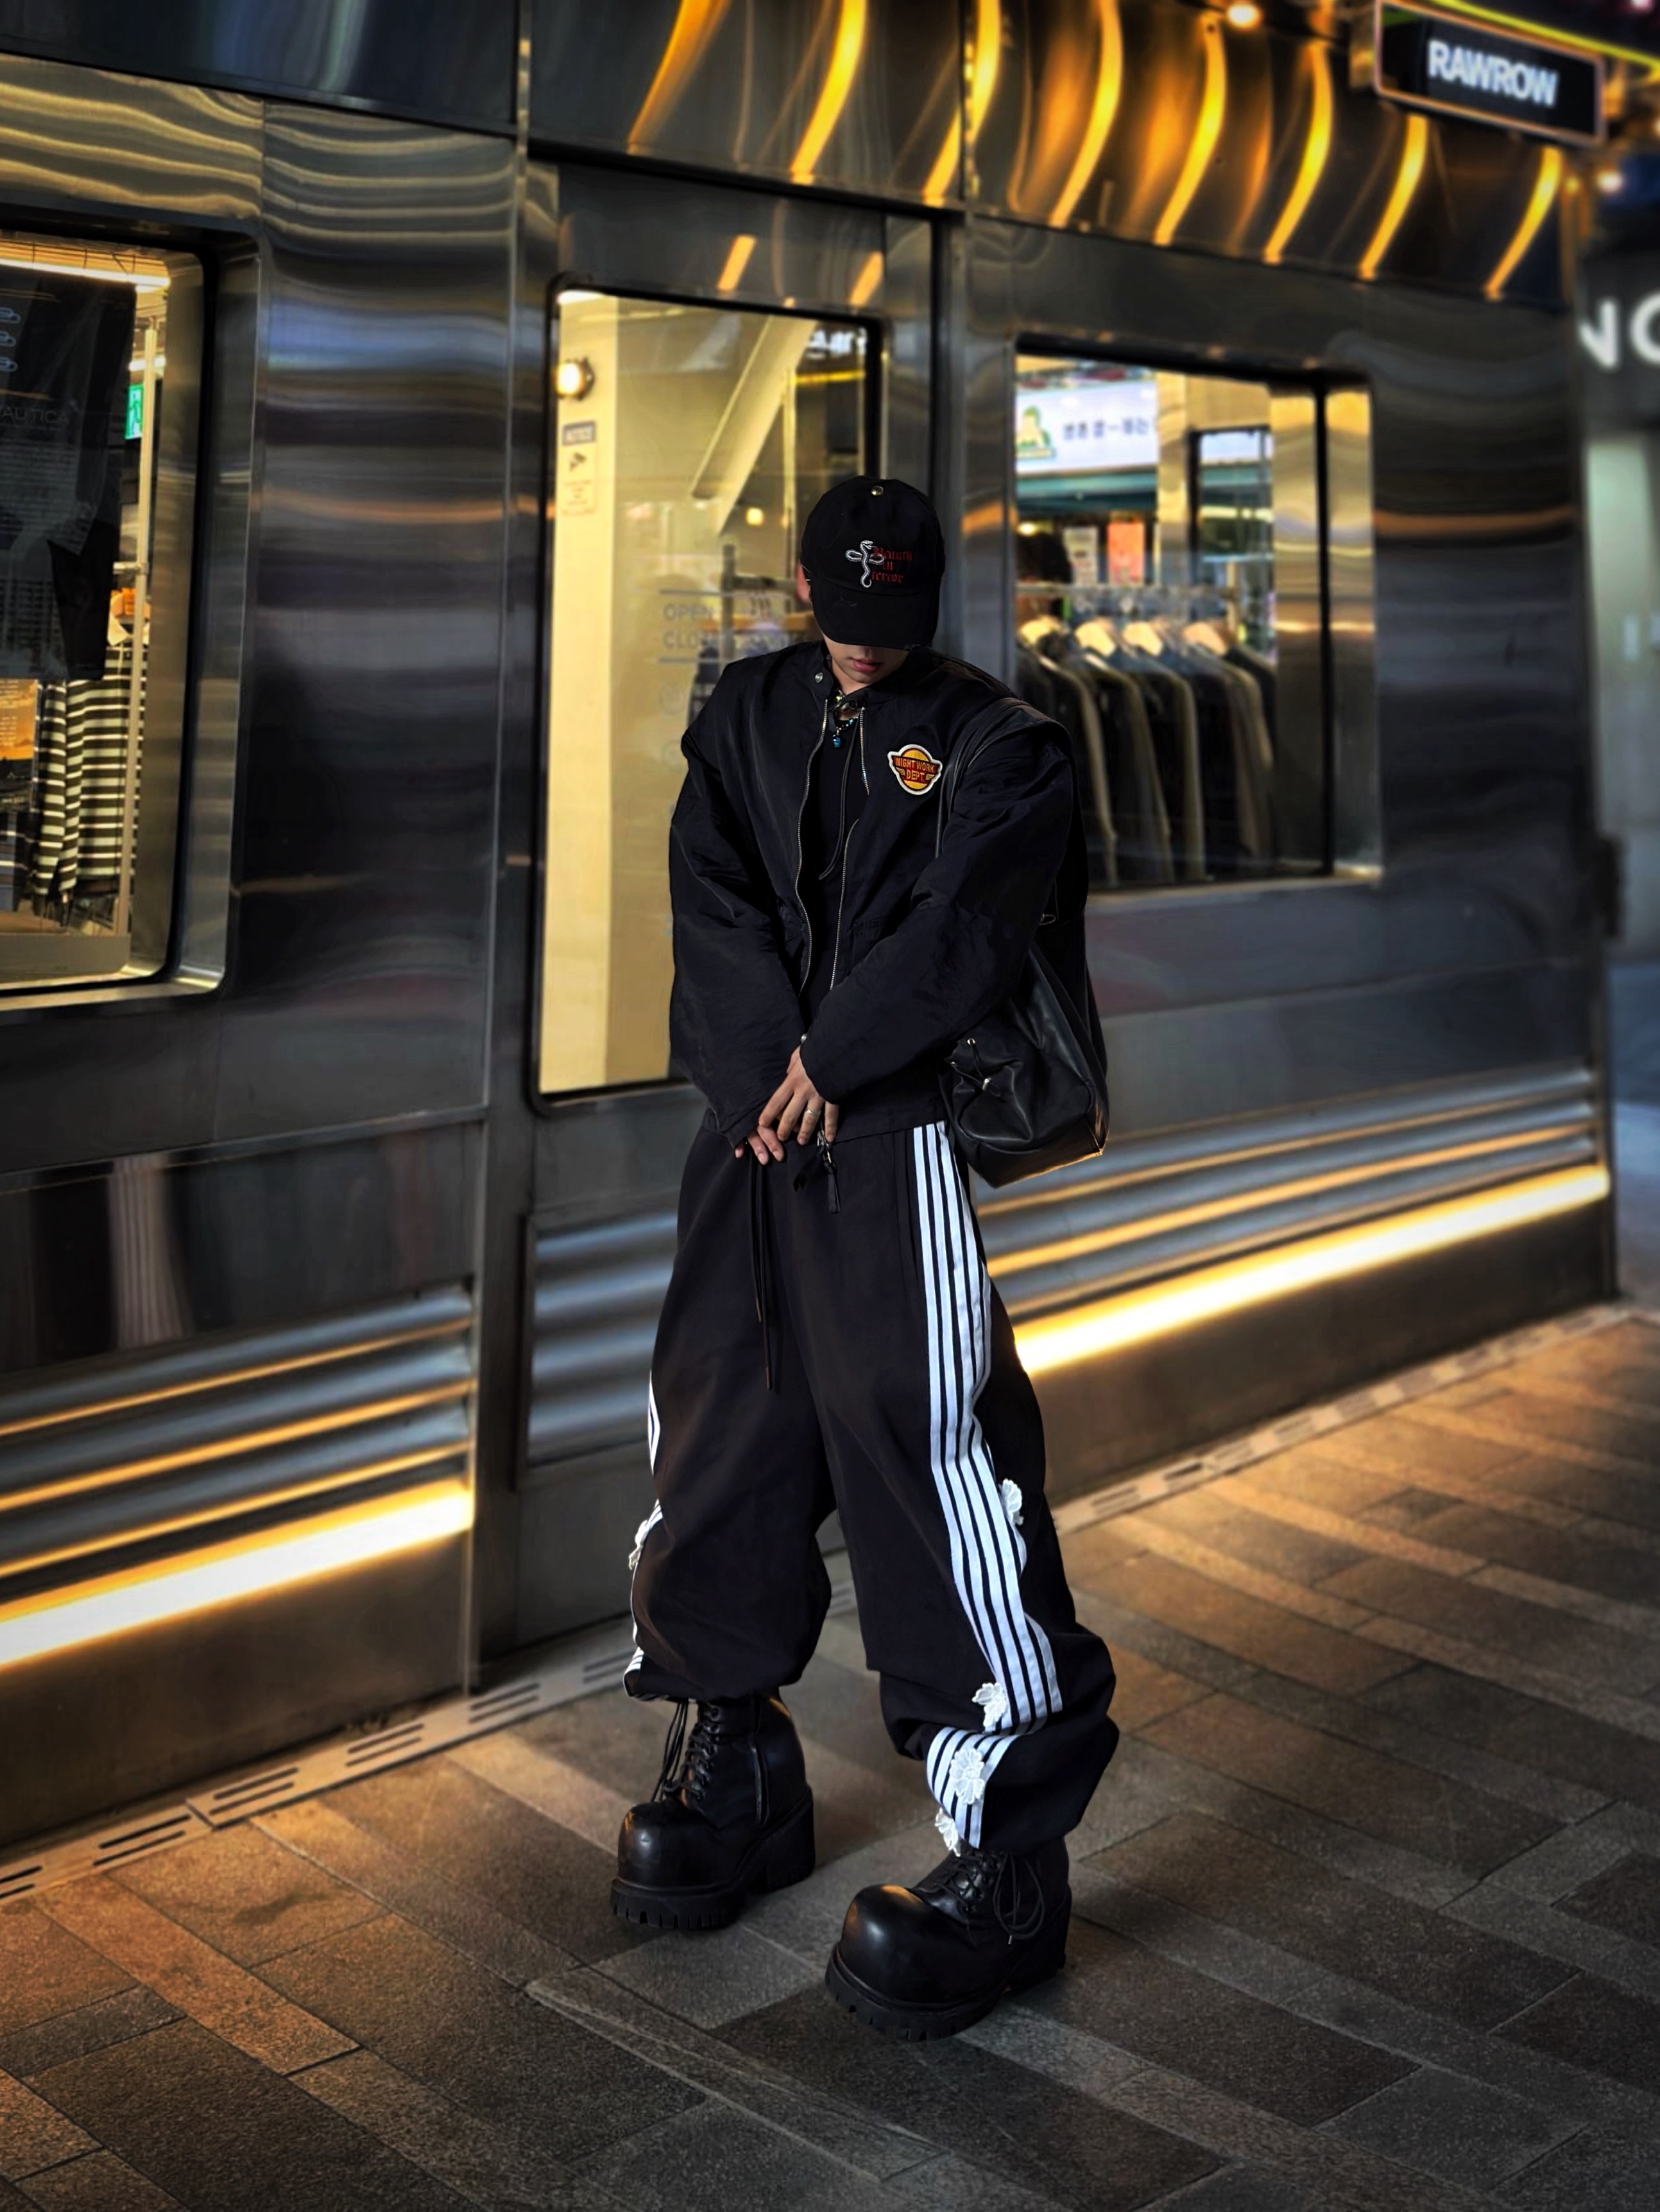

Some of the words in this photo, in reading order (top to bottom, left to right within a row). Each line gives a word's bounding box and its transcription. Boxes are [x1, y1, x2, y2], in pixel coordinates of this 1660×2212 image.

[1428, 39, 1559, 106] RAWROW
[896, 758, 916, 768] NIGHT
[916, 761, 934, 773] WORK
